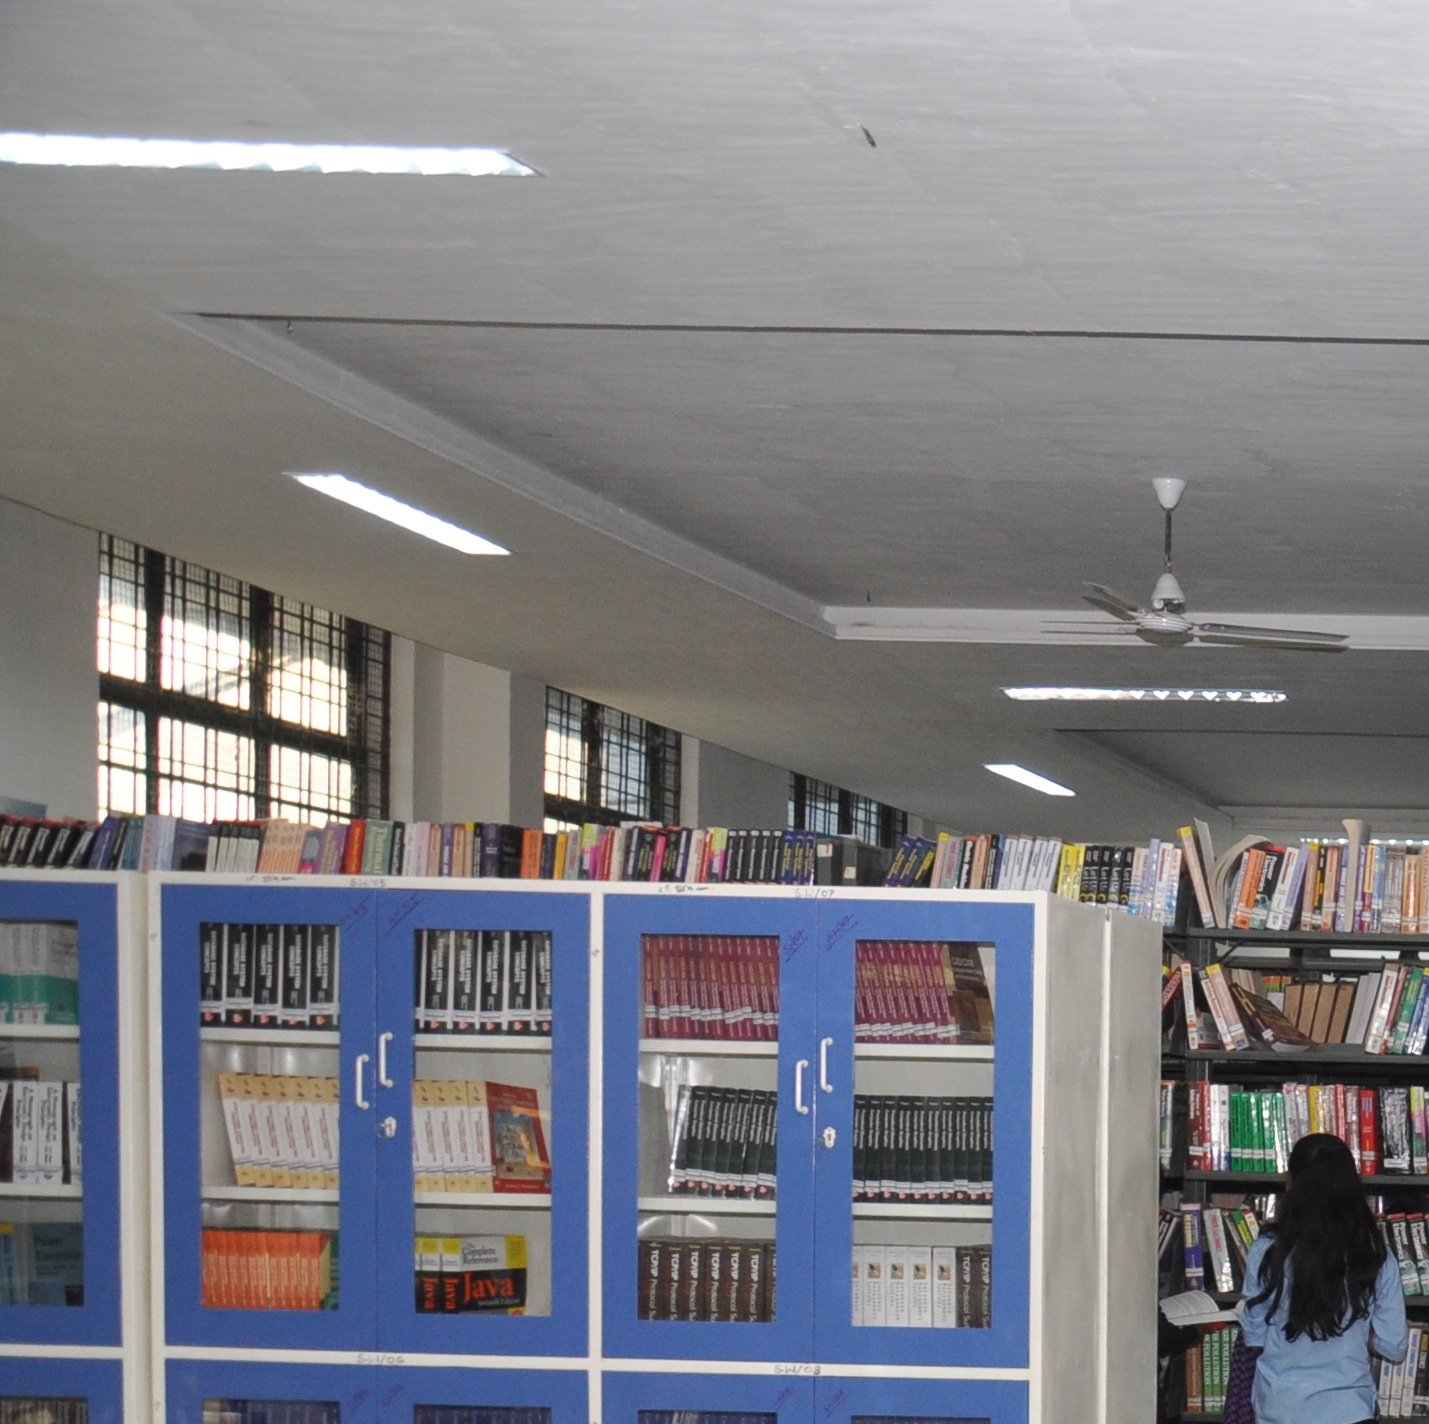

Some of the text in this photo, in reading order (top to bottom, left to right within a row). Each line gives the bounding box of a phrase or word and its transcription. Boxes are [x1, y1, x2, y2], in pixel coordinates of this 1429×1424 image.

[1393, 1223, 1404, 1260] Electronics
[1411, 1223, 1423, 1259] Electronics
[1419, 1222, 1427, 1245] Power
[651, 1250, 659, 1277] TCP/IP
[671, 1254, 679, 1280] TCP/IP
[691, 1251, 699, 1278] TCP/IP
[711, 1252, 720, 1280] TCP/IP
[731, 1252, 739, 1280] TCP/IP
[751, 1255, 759, 1282] TCP/IP
[423, 1277, 438, 1310] Java
[444, 1278, 459, 1310] Java
[464, 1271, 514, 1303] Java
